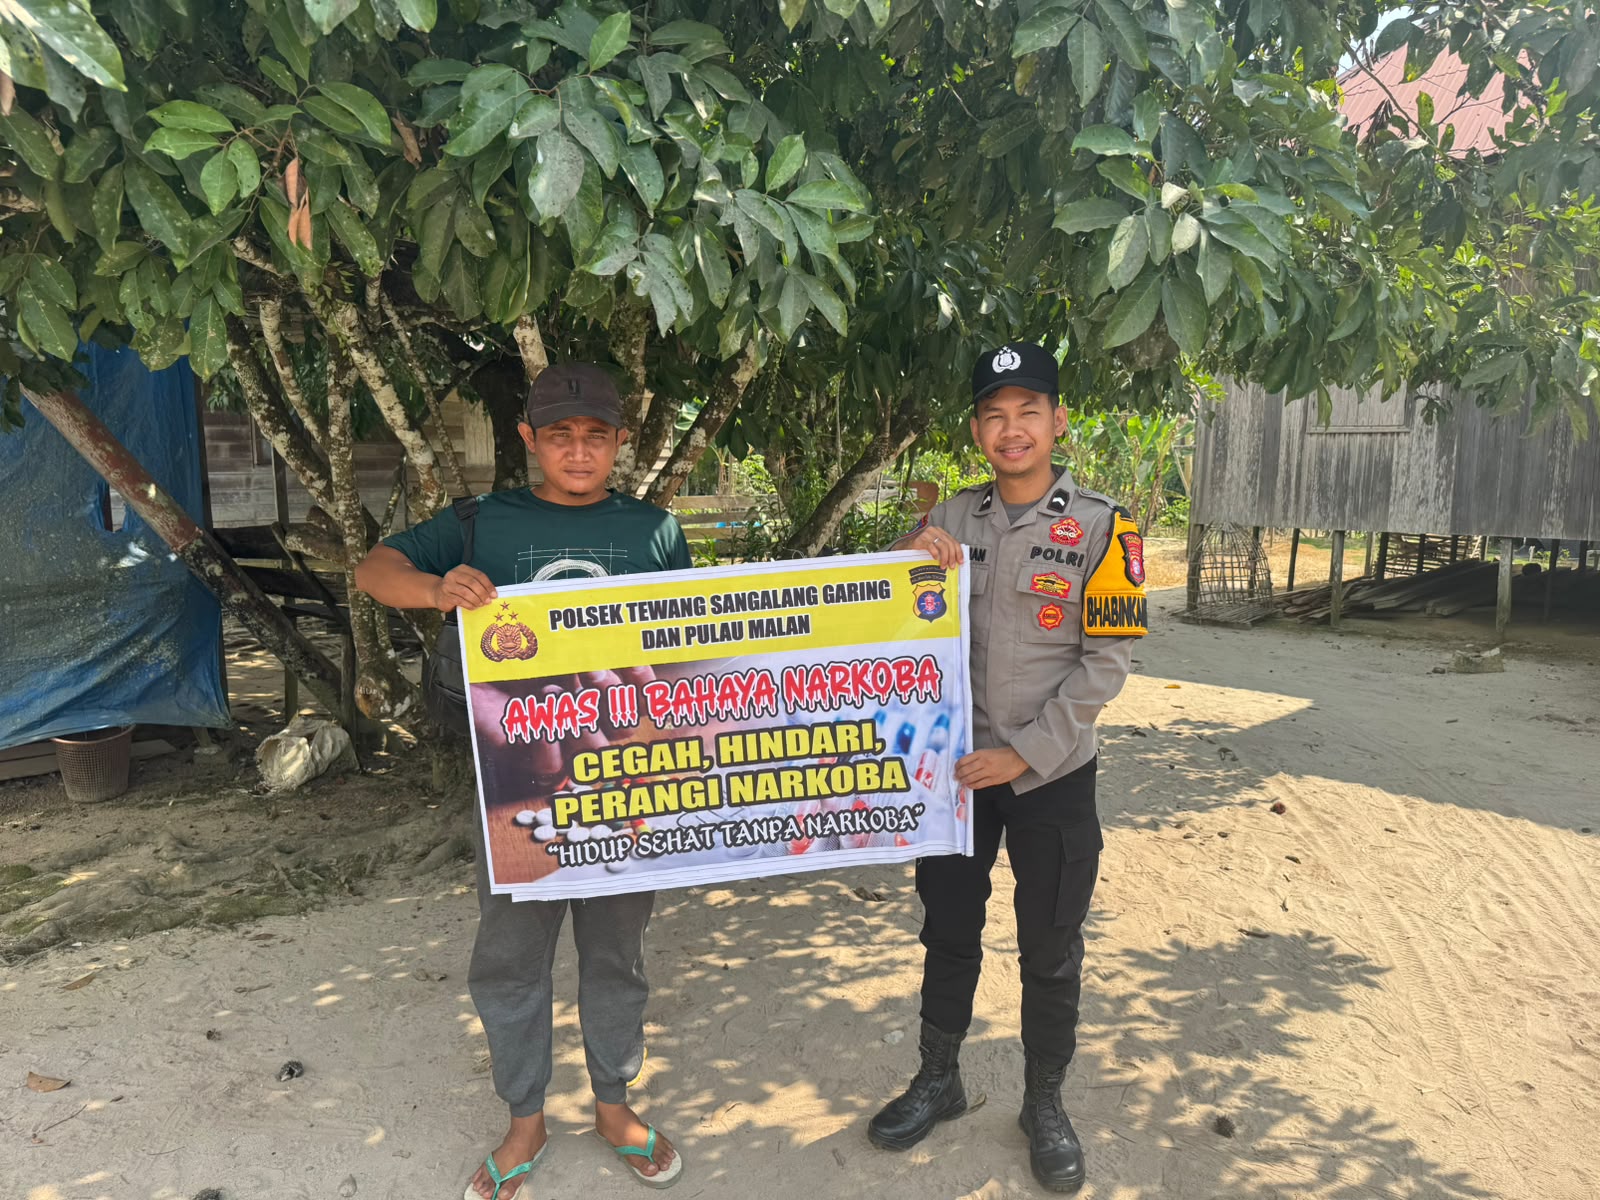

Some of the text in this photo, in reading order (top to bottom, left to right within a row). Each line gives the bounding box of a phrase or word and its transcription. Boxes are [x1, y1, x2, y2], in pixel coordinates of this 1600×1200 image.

[1030, 546, 1084, 567] POLRI
[549, 580, 891, 631] POLSEK TEWANG SANGALANG GARING
[641, 614, 810, 650] DAN PULAU MALAN
[503, 689, 600, 743] AWAS
[643, 669, 777, 727] BAHAYA
[782, 655, 941, 713] NARKOBA
[573, 722, 883, 783] CEGAH, HINDARI,
[554, 760, 907, 826] PERANGI NARKOBA
[547, 804, 924, 866] “HIDUP SEHAT TANPA NARKOBA”
